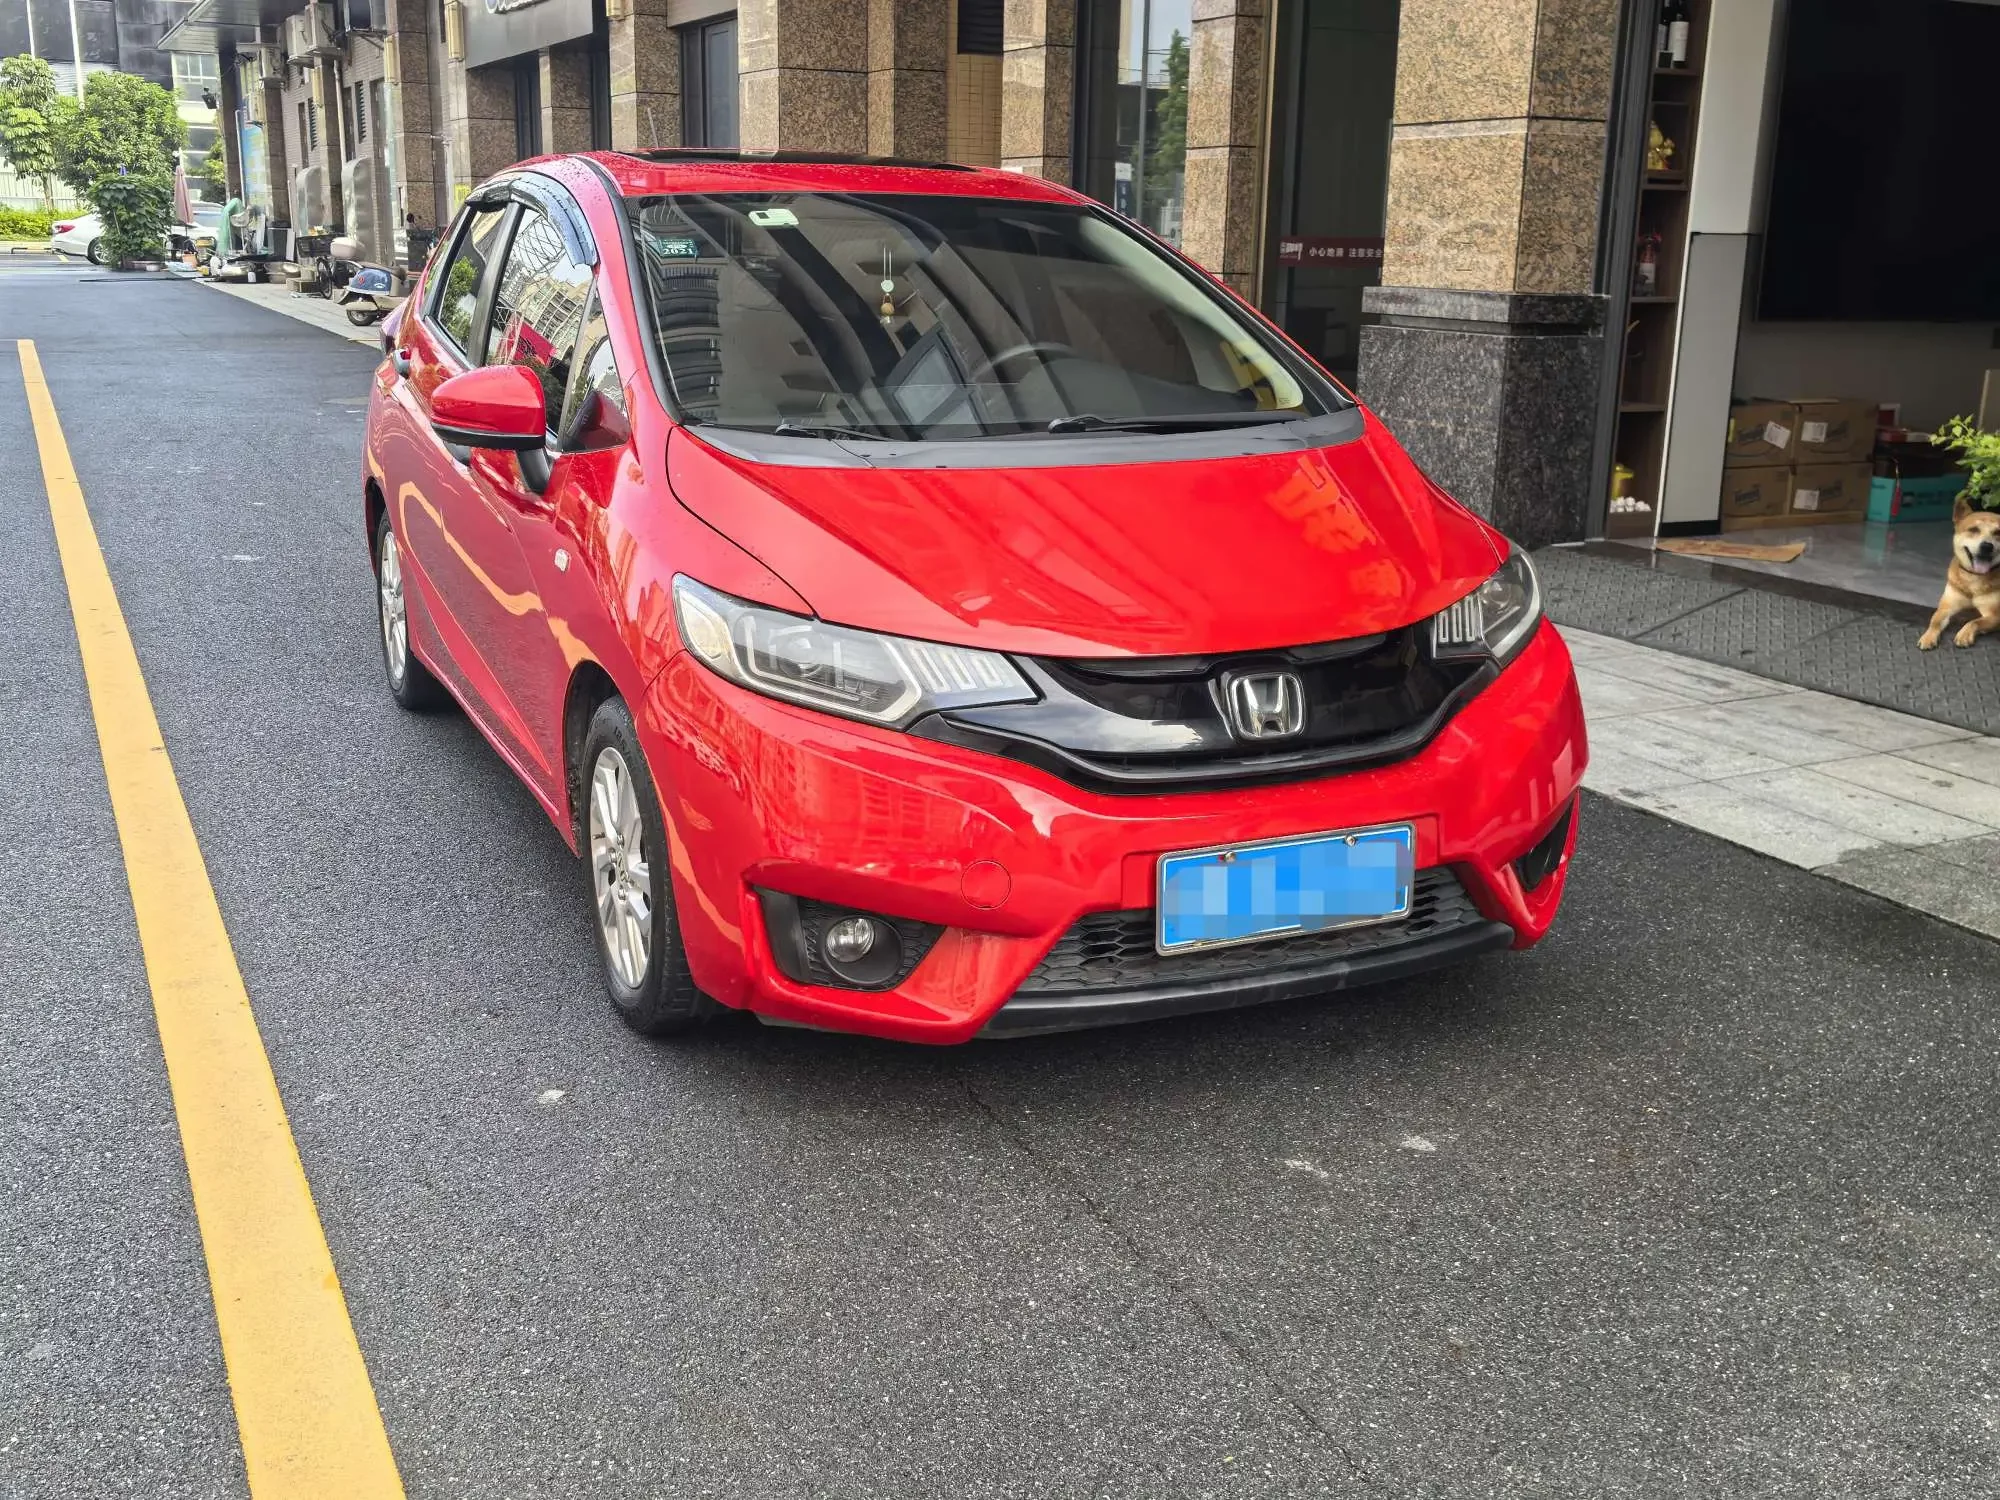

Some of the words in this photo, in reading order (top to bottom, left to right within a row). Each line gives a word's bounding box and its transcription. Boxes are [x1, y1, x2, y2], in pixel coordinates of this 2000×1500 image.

[1308, 247, 1344, 257] 小心地滑
[1348, 247, 1383, 258] 注意安全
